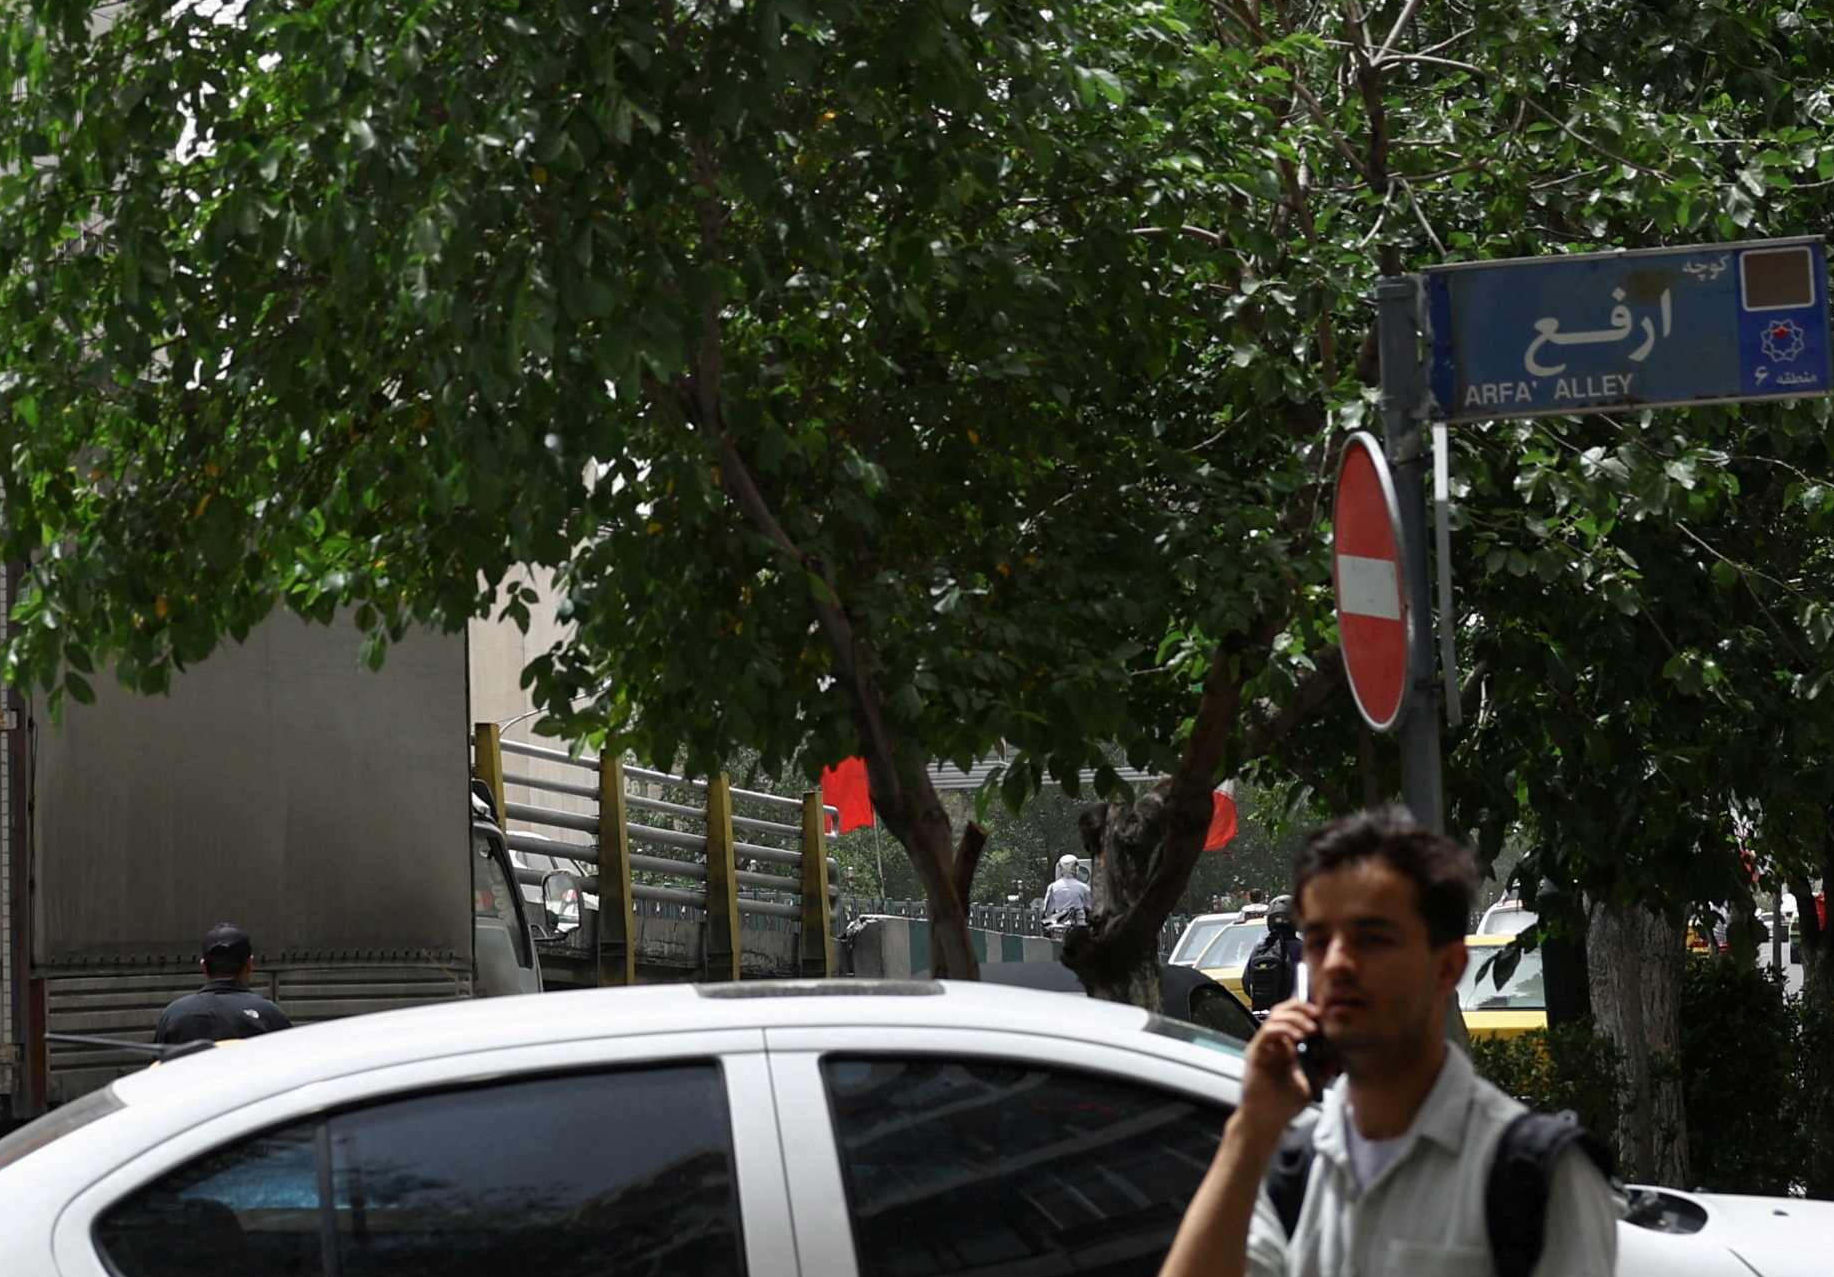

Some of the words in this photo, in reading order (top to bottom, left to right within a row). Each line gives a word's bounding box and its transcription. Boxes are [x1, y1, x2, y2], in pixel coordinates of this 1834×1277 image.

[1683, 254, 1732, 281] کوچه
[1524, 287, 1672, 378] ارفع
[1755, 366, 1768, 386] ۶
[1776, 371, 1817, 384] منطقه
[1465, 381, 1538, 407] ARFA'
[1554, 373, 1633, 399] ALLEY
